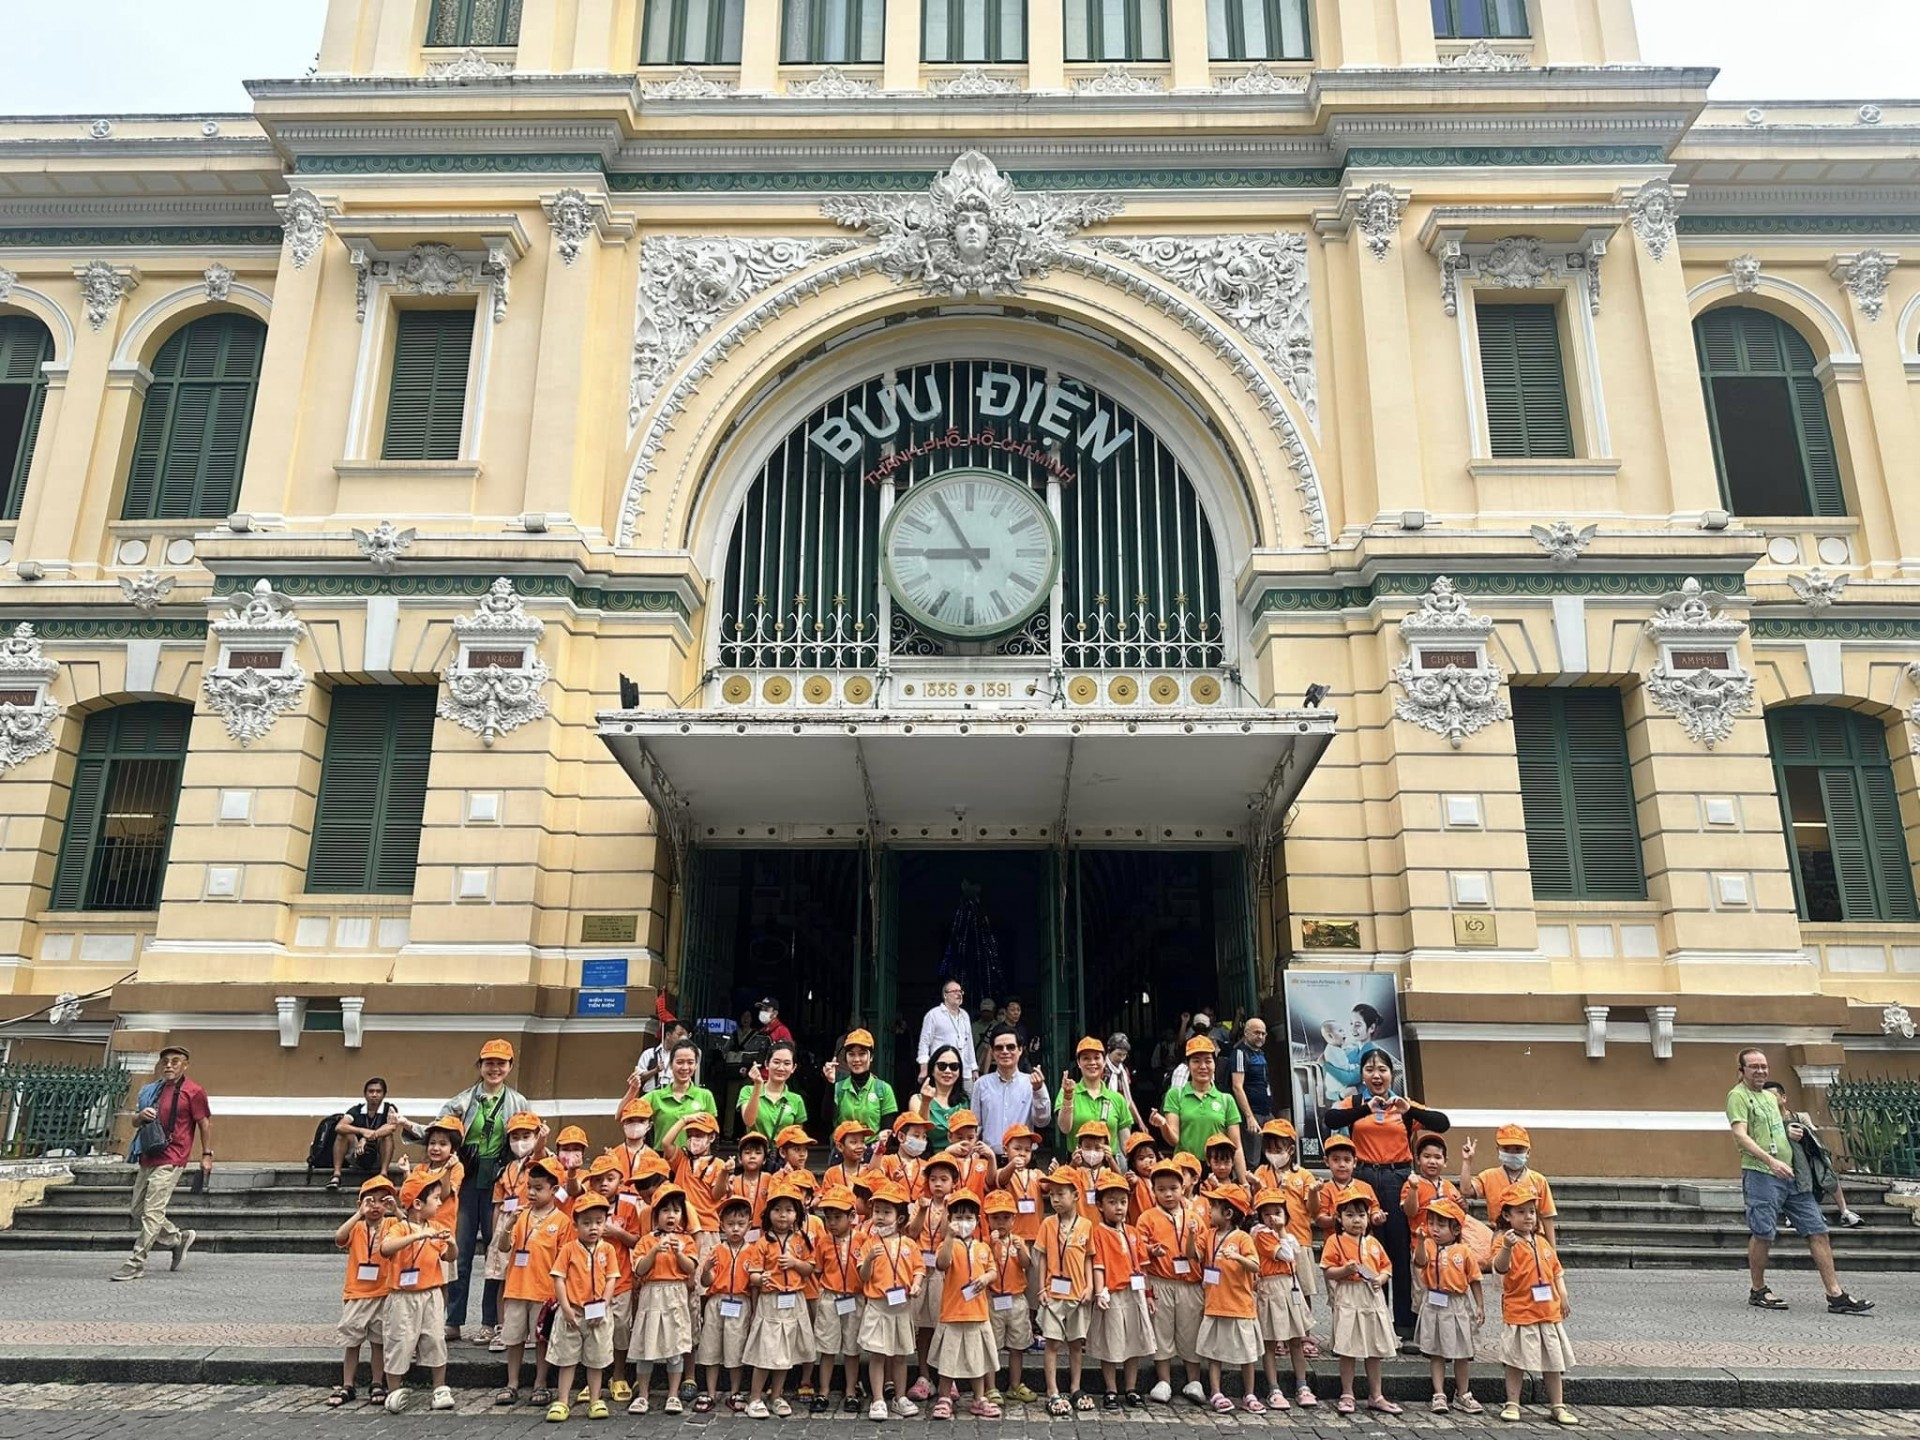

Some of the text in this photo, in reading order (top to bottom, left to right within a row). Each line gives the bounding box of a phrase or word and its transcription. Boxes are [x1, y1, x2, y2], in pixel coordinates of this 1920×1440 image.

[808, 370, 1134, 465] BƯU ĐIỆN
[1034, 452, 1076, 483] MINH
[486, 655, 516, 664] ARAGO
[1430, 655, 1468, 664] CHAPPE
[982, 682, 1012, 697] 1891
